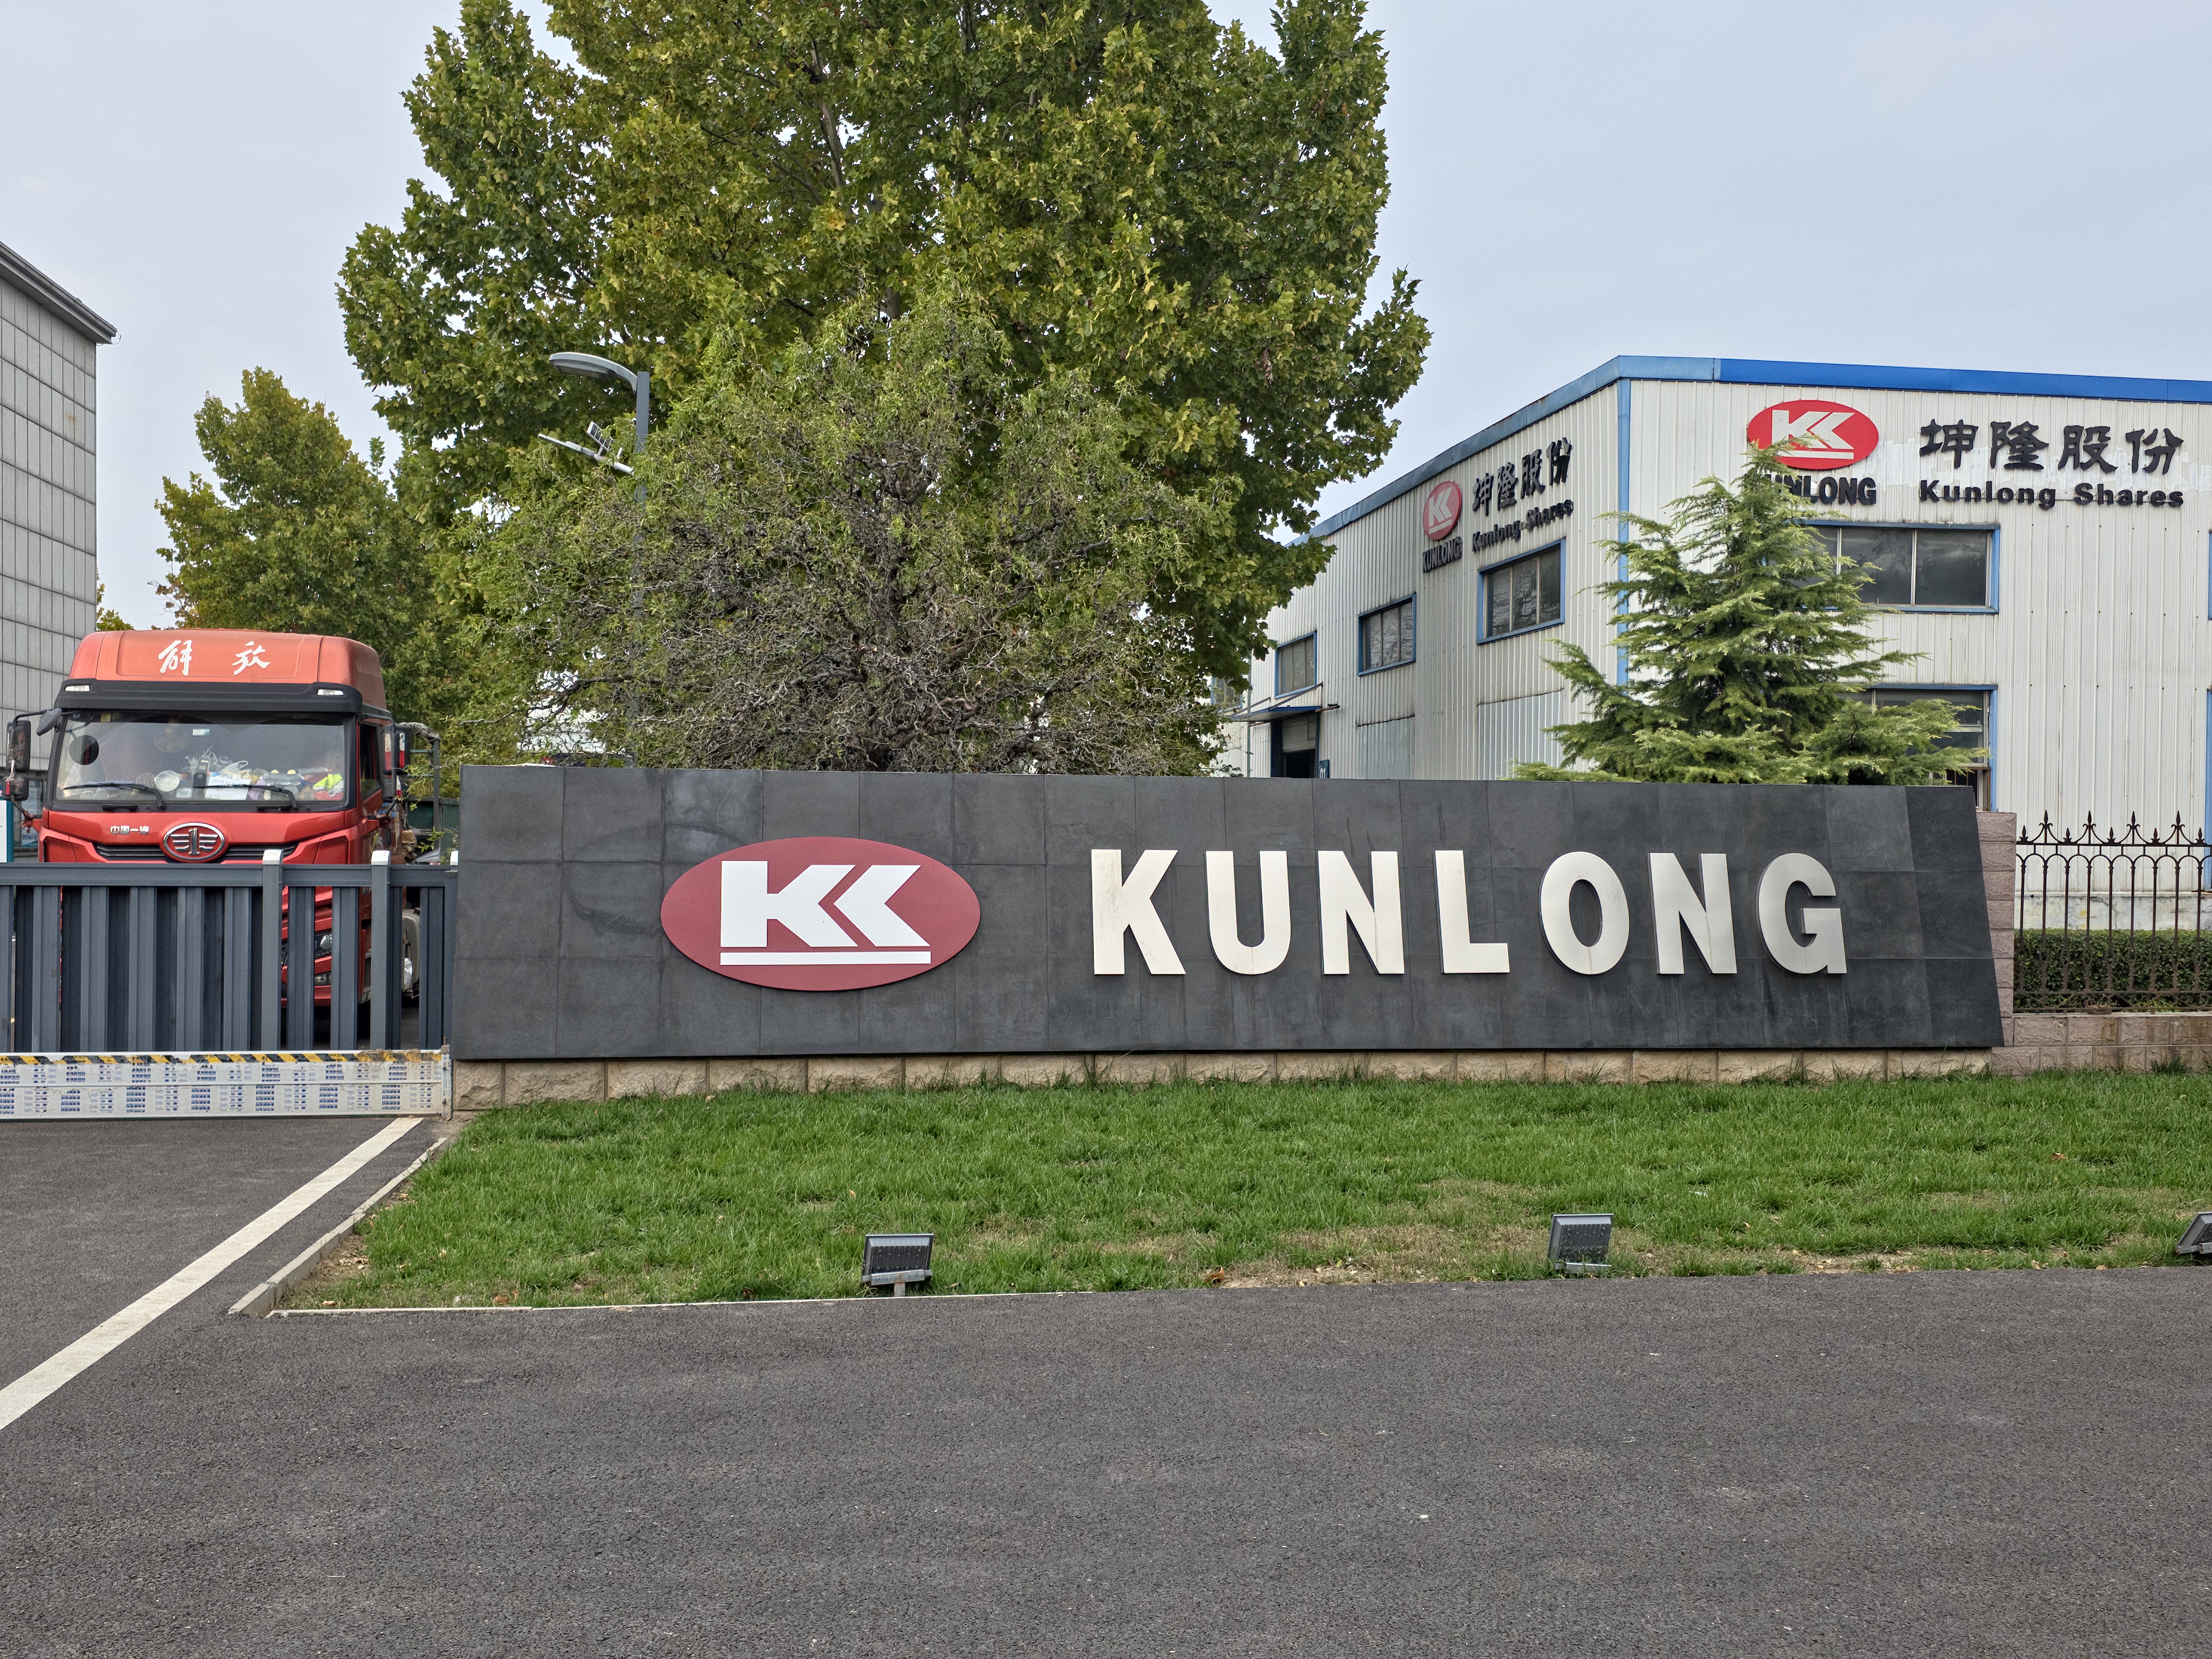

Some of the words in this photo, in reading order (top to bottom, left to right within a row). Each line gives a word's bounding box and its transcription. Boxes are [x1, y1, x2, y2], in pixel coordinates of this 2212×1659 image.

[1920, 419, 2184, 475] 坤隆股份
[1472, 437, 1572, 517] 坤隆股份
[1919, 480, 2056, 510] Kunlong
[2074, 483, 2184, 508] Shares
[1473, 520, 1521, 553] Kunlong
[1526, 500, 1574, 532] Shares
[1423, 536, 1463, 573] KUNLONG
[1090, 849, 1847, 975] KUNLONG
